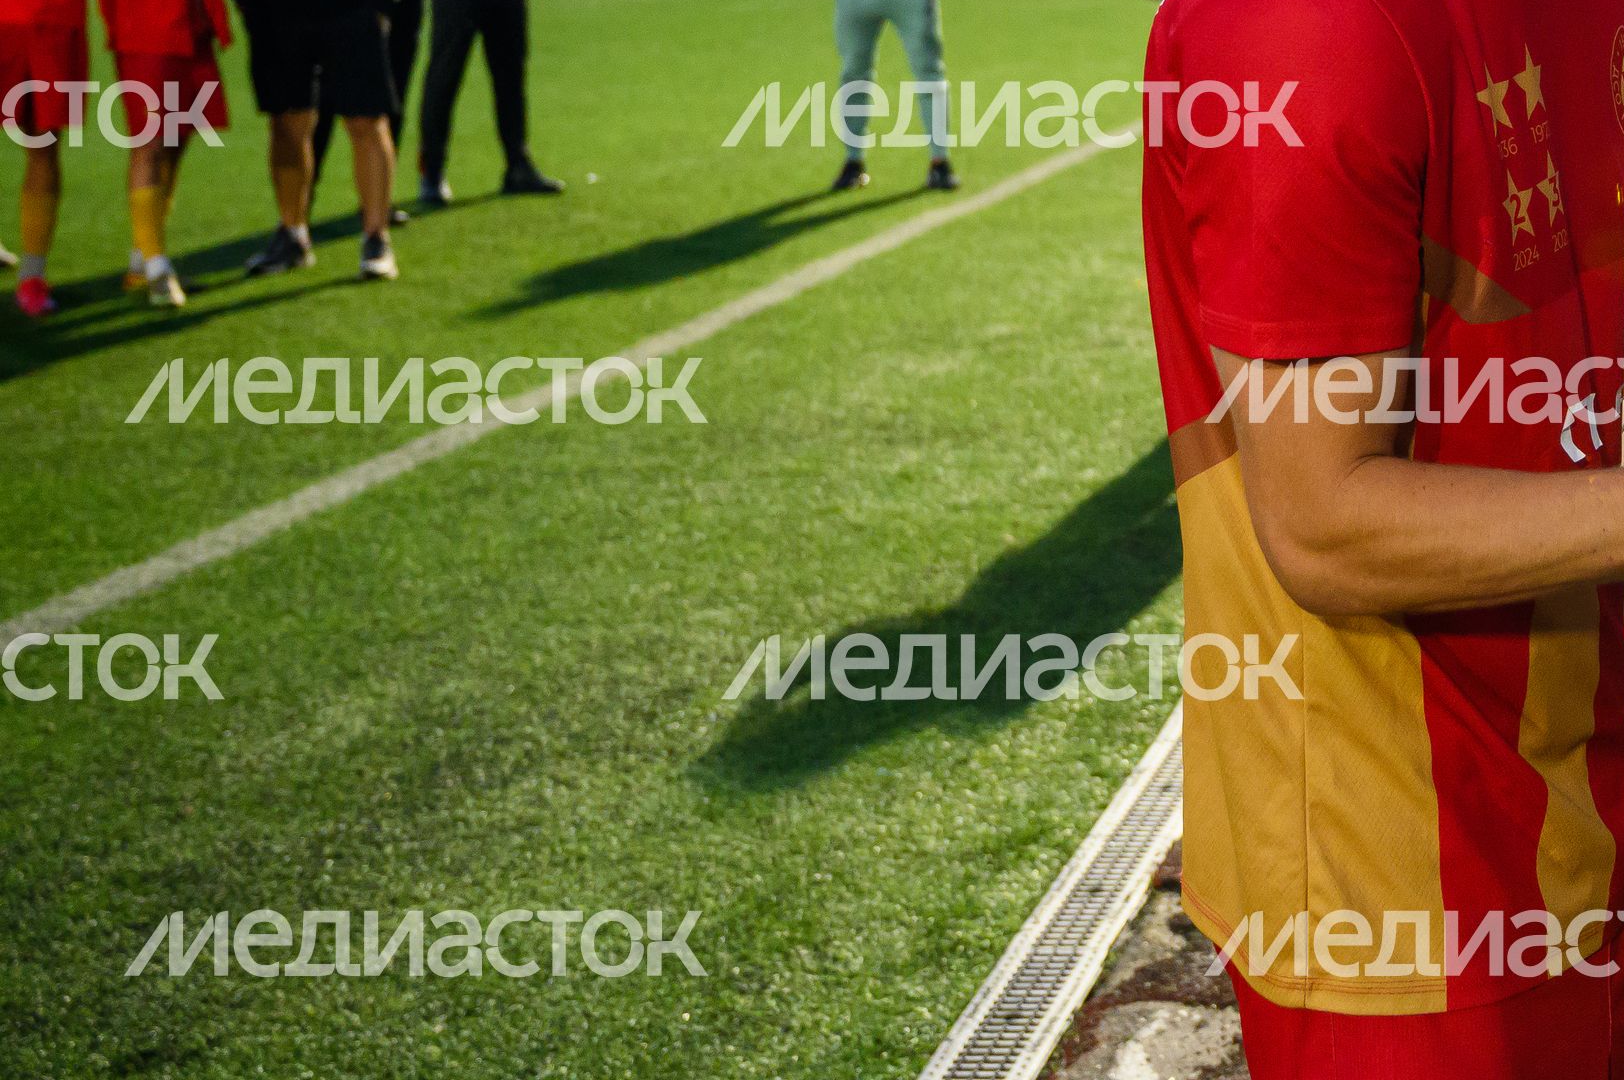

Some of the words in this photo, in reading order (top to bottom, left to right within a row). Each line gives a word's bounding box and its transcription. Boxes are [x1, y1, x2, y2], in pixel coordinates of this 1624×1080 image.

[1497, 136, 1518, 159] 36
[1508, 193, 1527, 227] 2
[1513, 245, 1541, 272] 2024
[1552, 228, 1569, 253] 202
